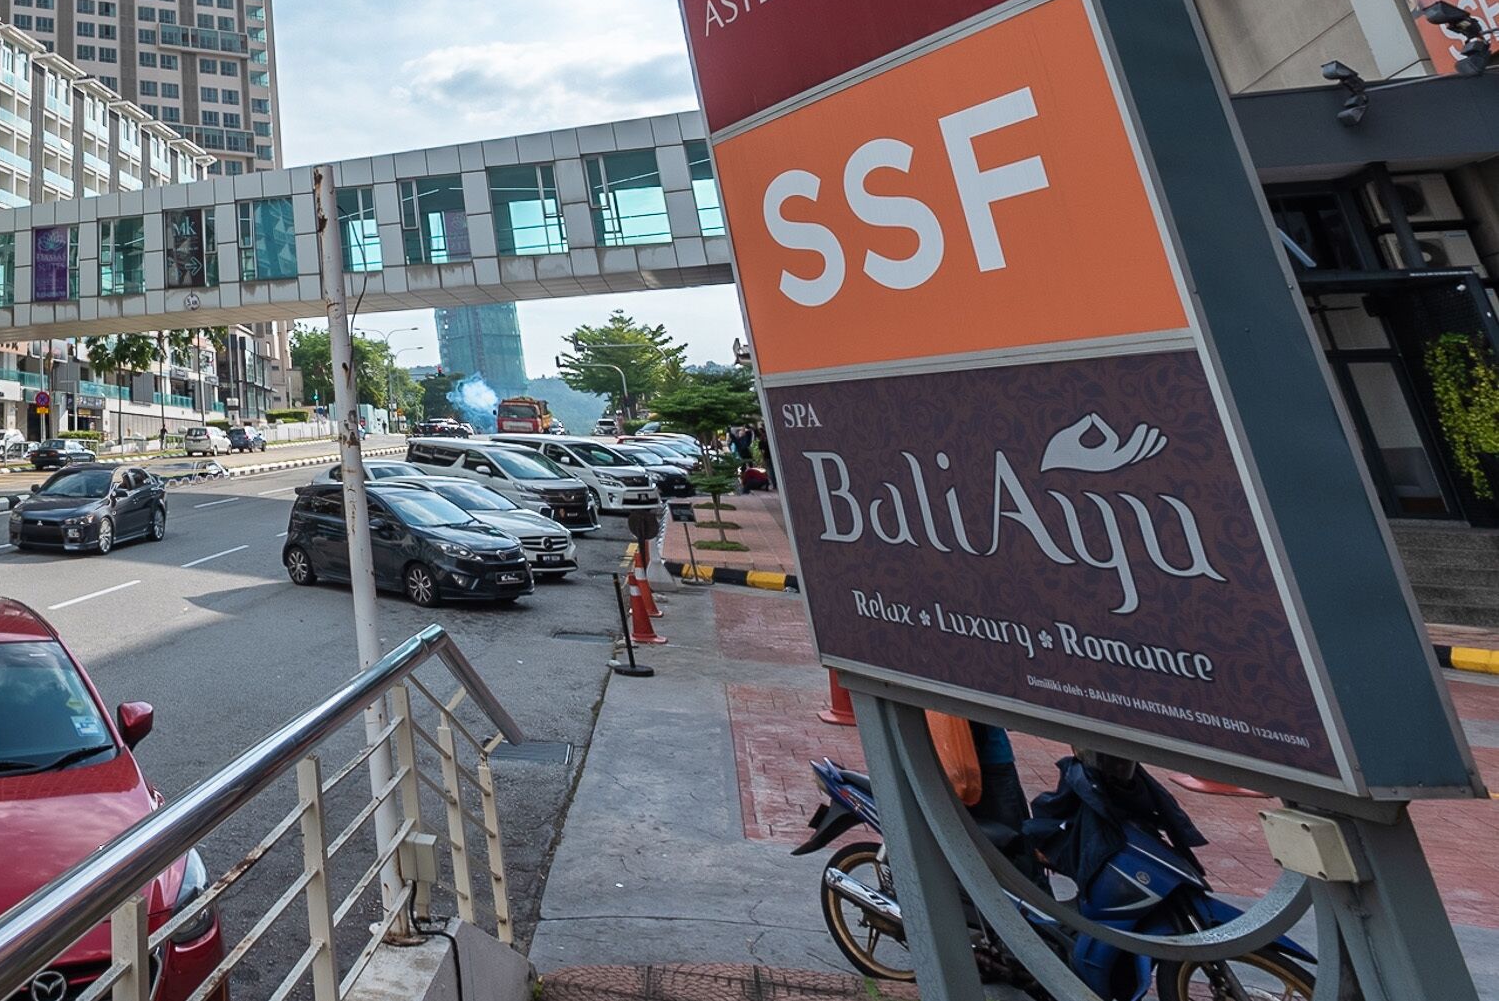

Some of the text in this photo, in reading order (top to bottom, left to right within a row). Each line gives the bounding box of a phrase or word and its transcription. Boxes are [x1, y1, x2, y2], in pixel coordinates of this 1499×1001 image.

[762, 85, 1050, 307] SSF
[781, 403, 822, 430] SPA
[851, 589, 1214, 683] Relax Luxury Romance
[1027, 674, 1062, 693] Dimiliki
[1089, 687, 1131, 708] BALIAYU
[1133, 698, 1195, 722] HARTAMAS
[1195, 712, 1221, 729] SDN
[1222, 717, 1250, 735] BHD
[1251, 725, 1311, 749] (1224105M)
